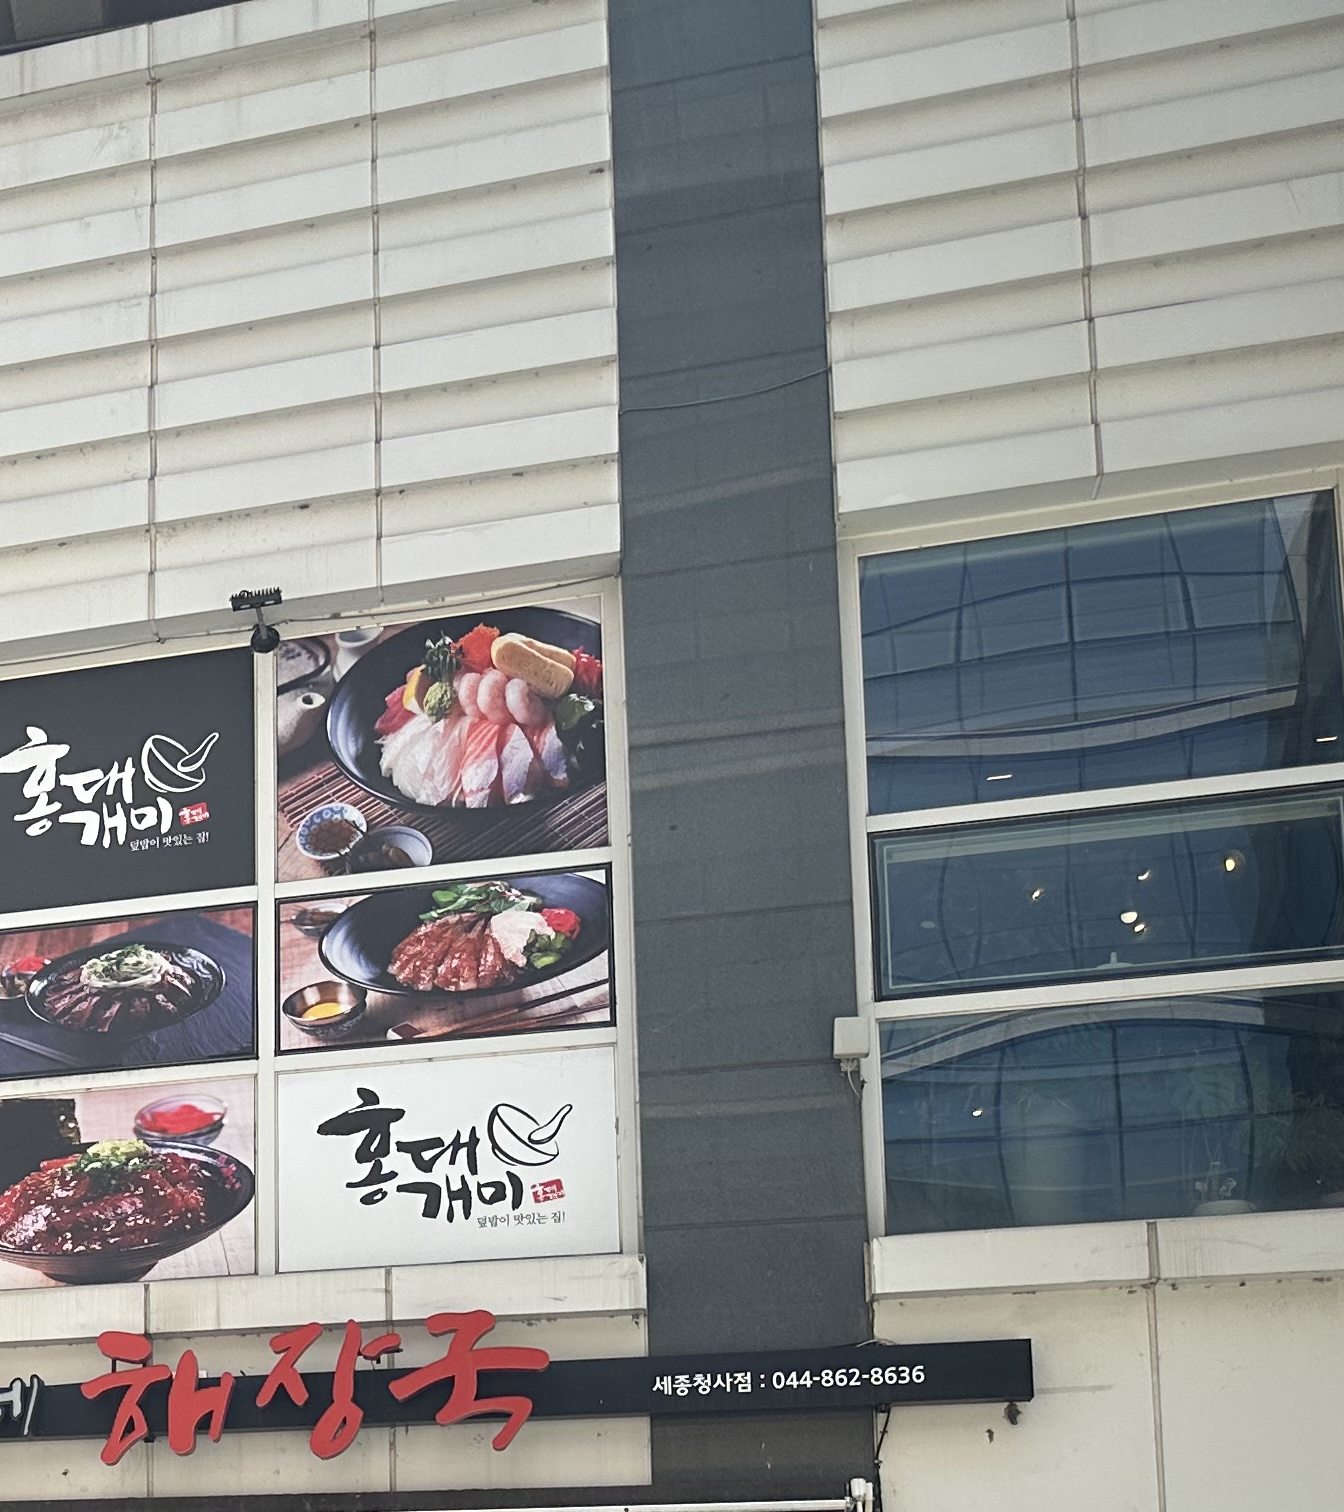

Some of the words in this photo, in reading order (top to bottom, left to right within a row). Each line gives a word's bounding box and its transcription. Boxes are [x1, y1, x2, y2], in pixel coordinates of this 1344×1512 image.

[162, 834, 193, 849] 맛있는
[513, 1210, 547, 1225] 맛있는
[80, 1309, 552, 1467] 해장국
[651, 1371, 752, 1397] 세종청사점
[771, 1365, 926, 1391] 044-862-8636
